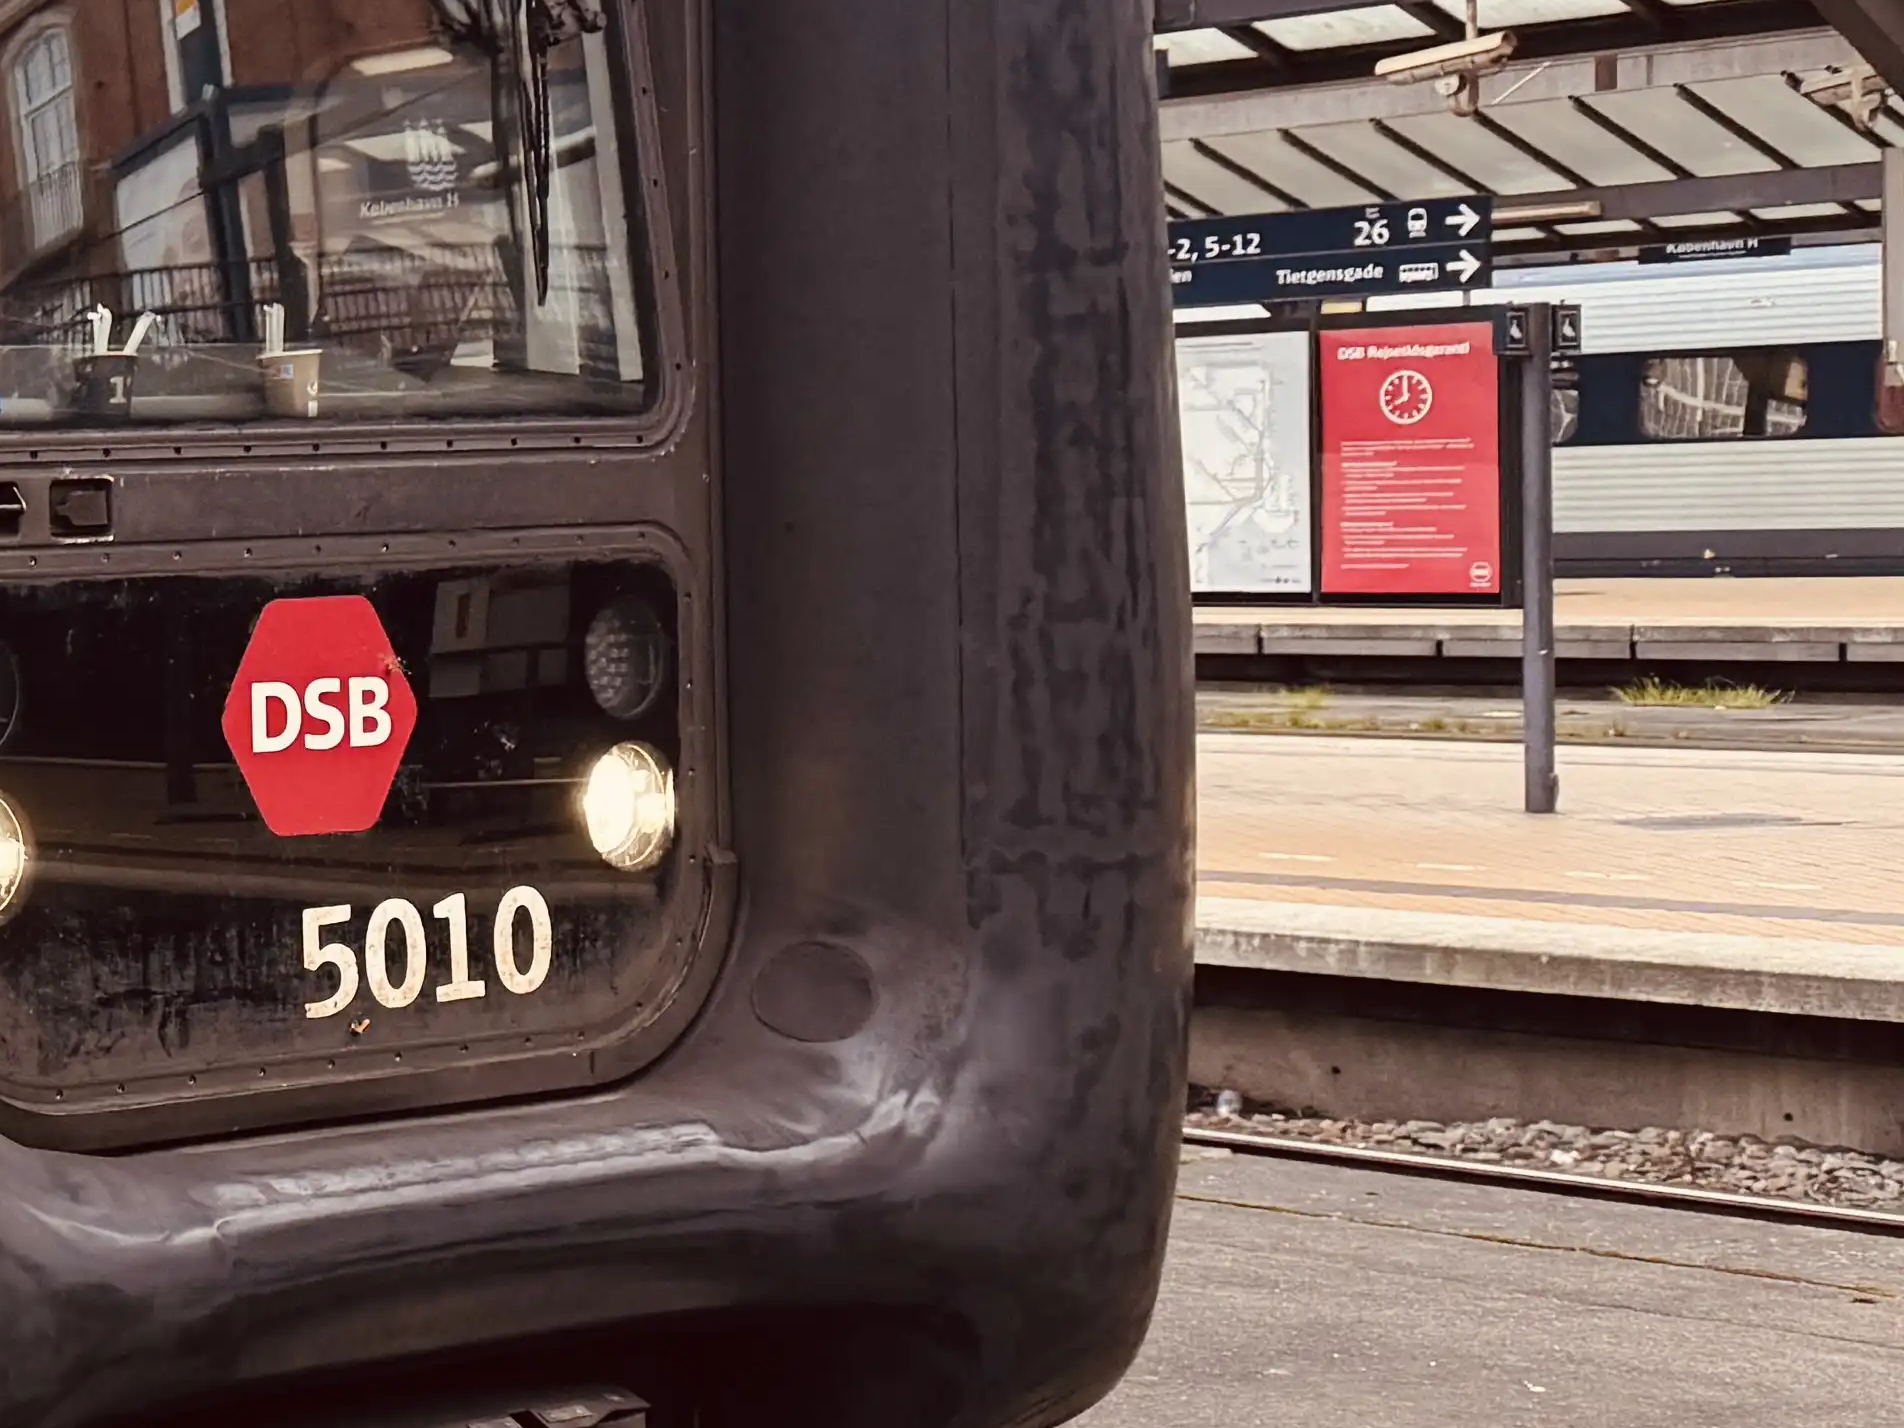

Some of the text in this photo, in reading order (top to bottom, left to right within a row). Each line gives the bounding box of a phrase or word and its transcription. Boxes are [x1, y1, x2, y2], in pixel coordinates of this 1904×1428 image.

[1205, 233, 1261, 258] 5-12
[1354, 219, 1390, 246] 26
[1276, 263, 1384, 285] Tietgensgade
[250, 674, 392, 754] DSB
[302, 884, 553, 1019] 5010
